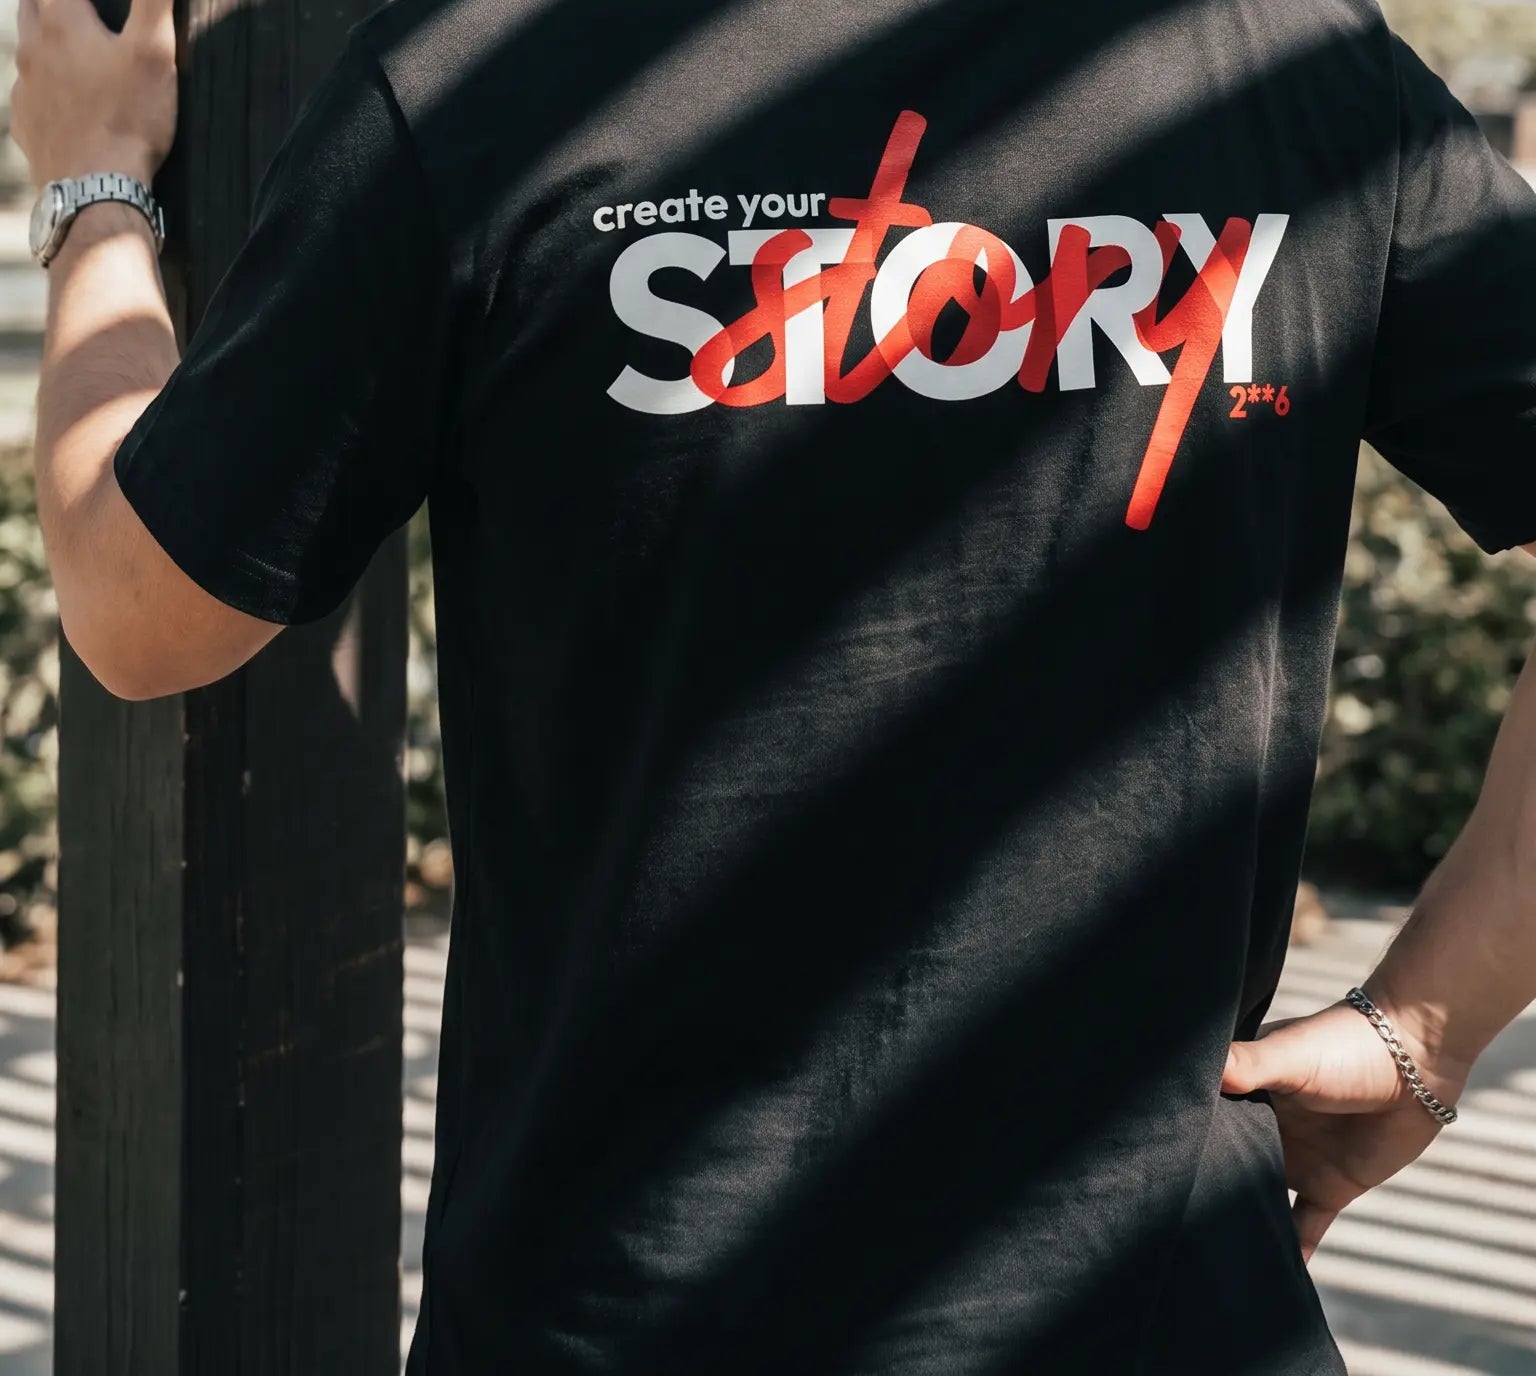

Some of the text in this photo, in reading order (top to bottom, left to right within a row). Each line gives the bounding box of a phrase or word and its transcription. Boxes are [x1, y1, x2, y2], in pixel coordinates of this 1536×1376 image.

[592, 188, 826, 232] create your
[606, 212, 1291, 416] STORY
